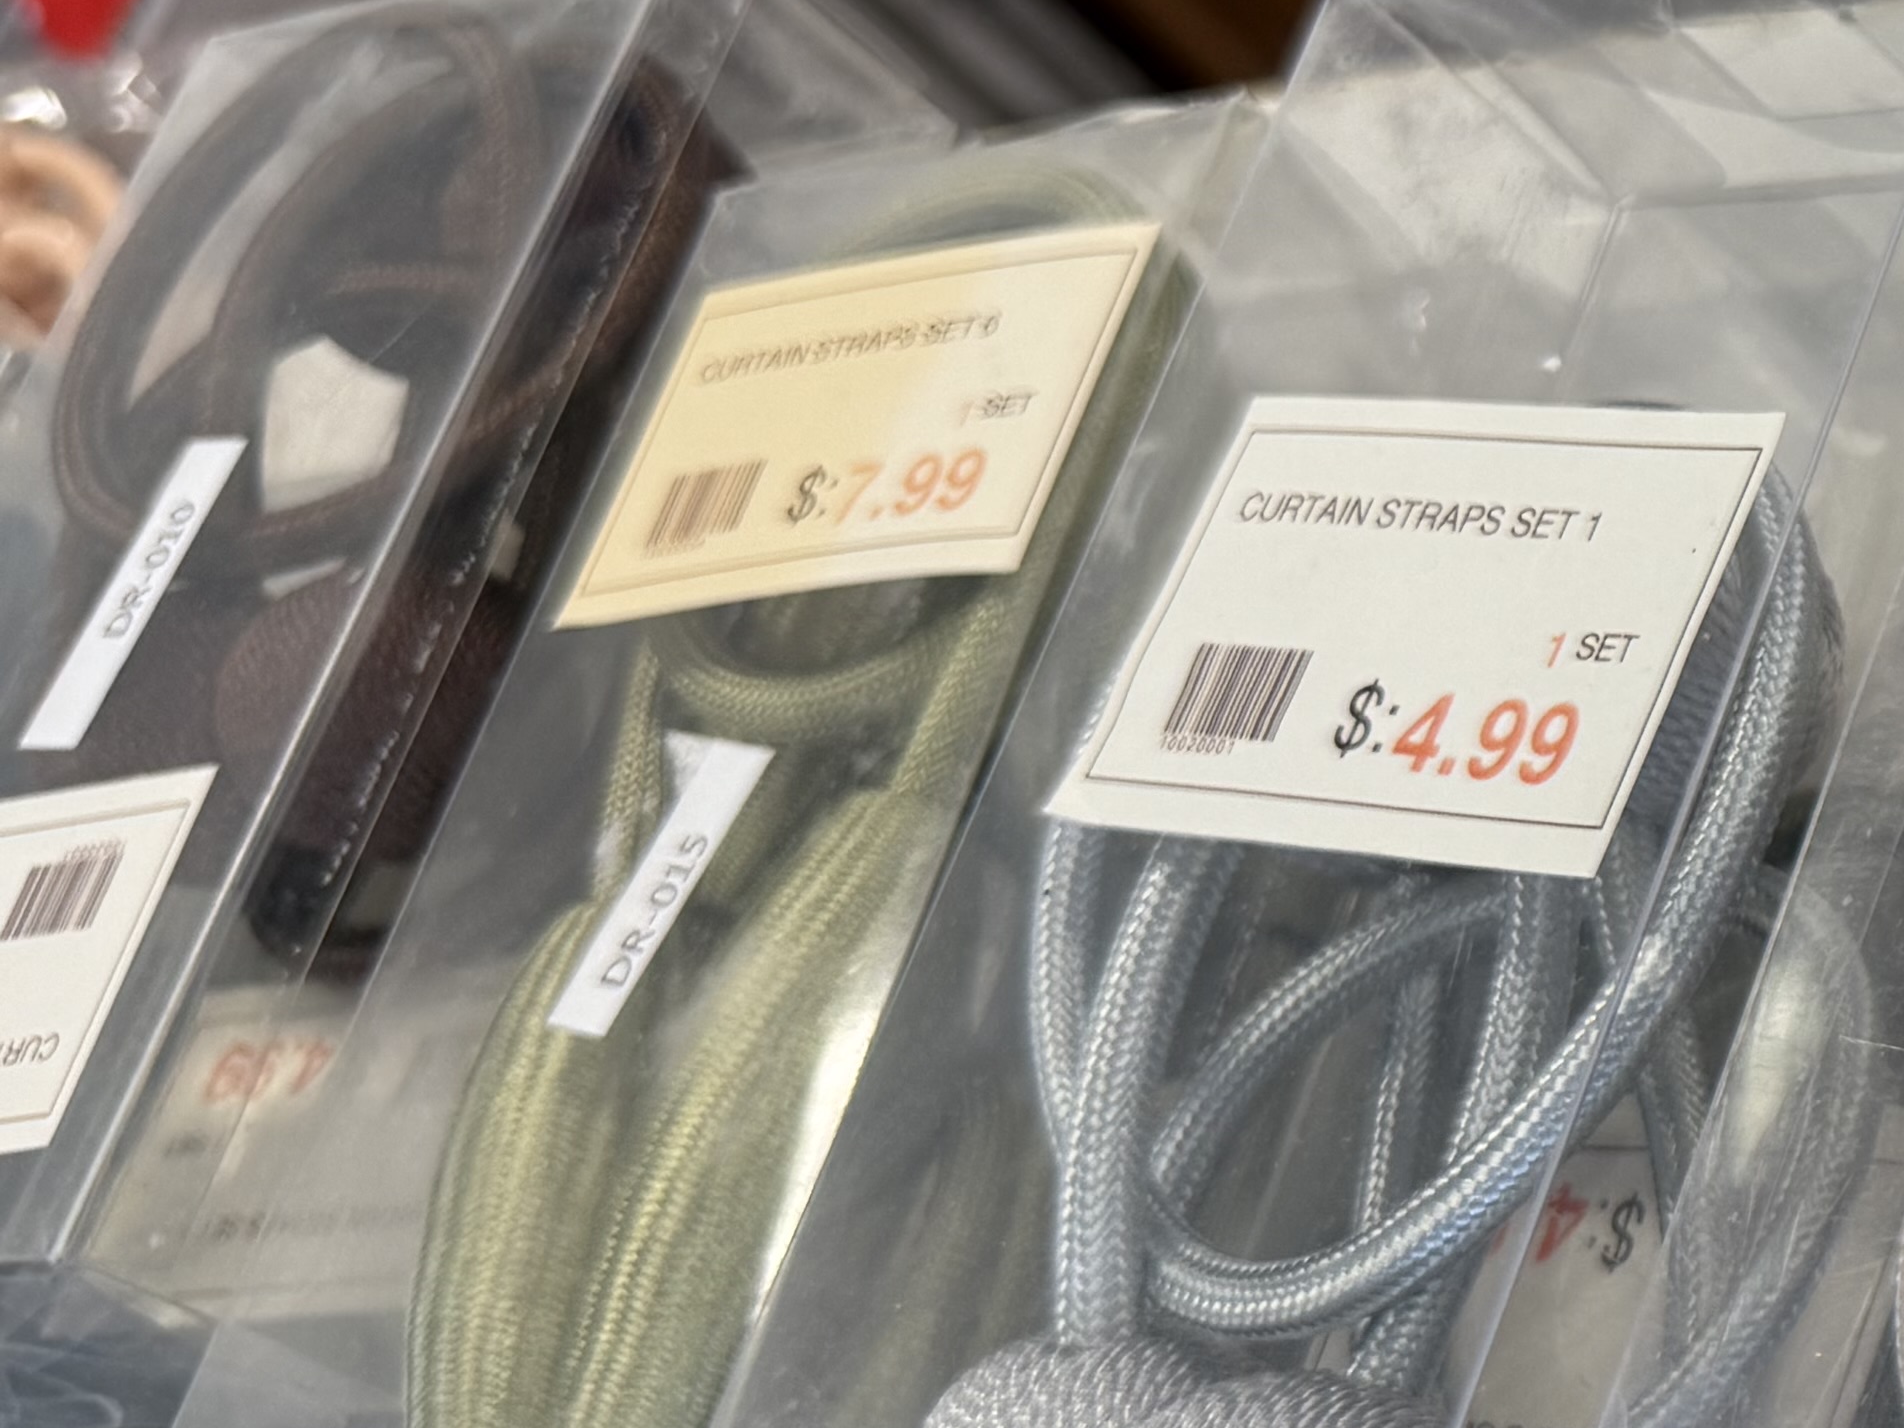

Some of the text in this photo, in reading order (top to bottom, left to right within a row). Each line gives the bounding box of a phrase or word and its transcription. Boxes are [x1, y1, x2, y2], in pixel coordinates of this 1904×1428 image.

[1239, 491, 1602, 542] CURTAIN STRAPS SET 1
[102, 500, 196, 639] DR-010
[1547, 632, 1640, 668] 1 SET
[600, 834, 709, 988] DR-015
